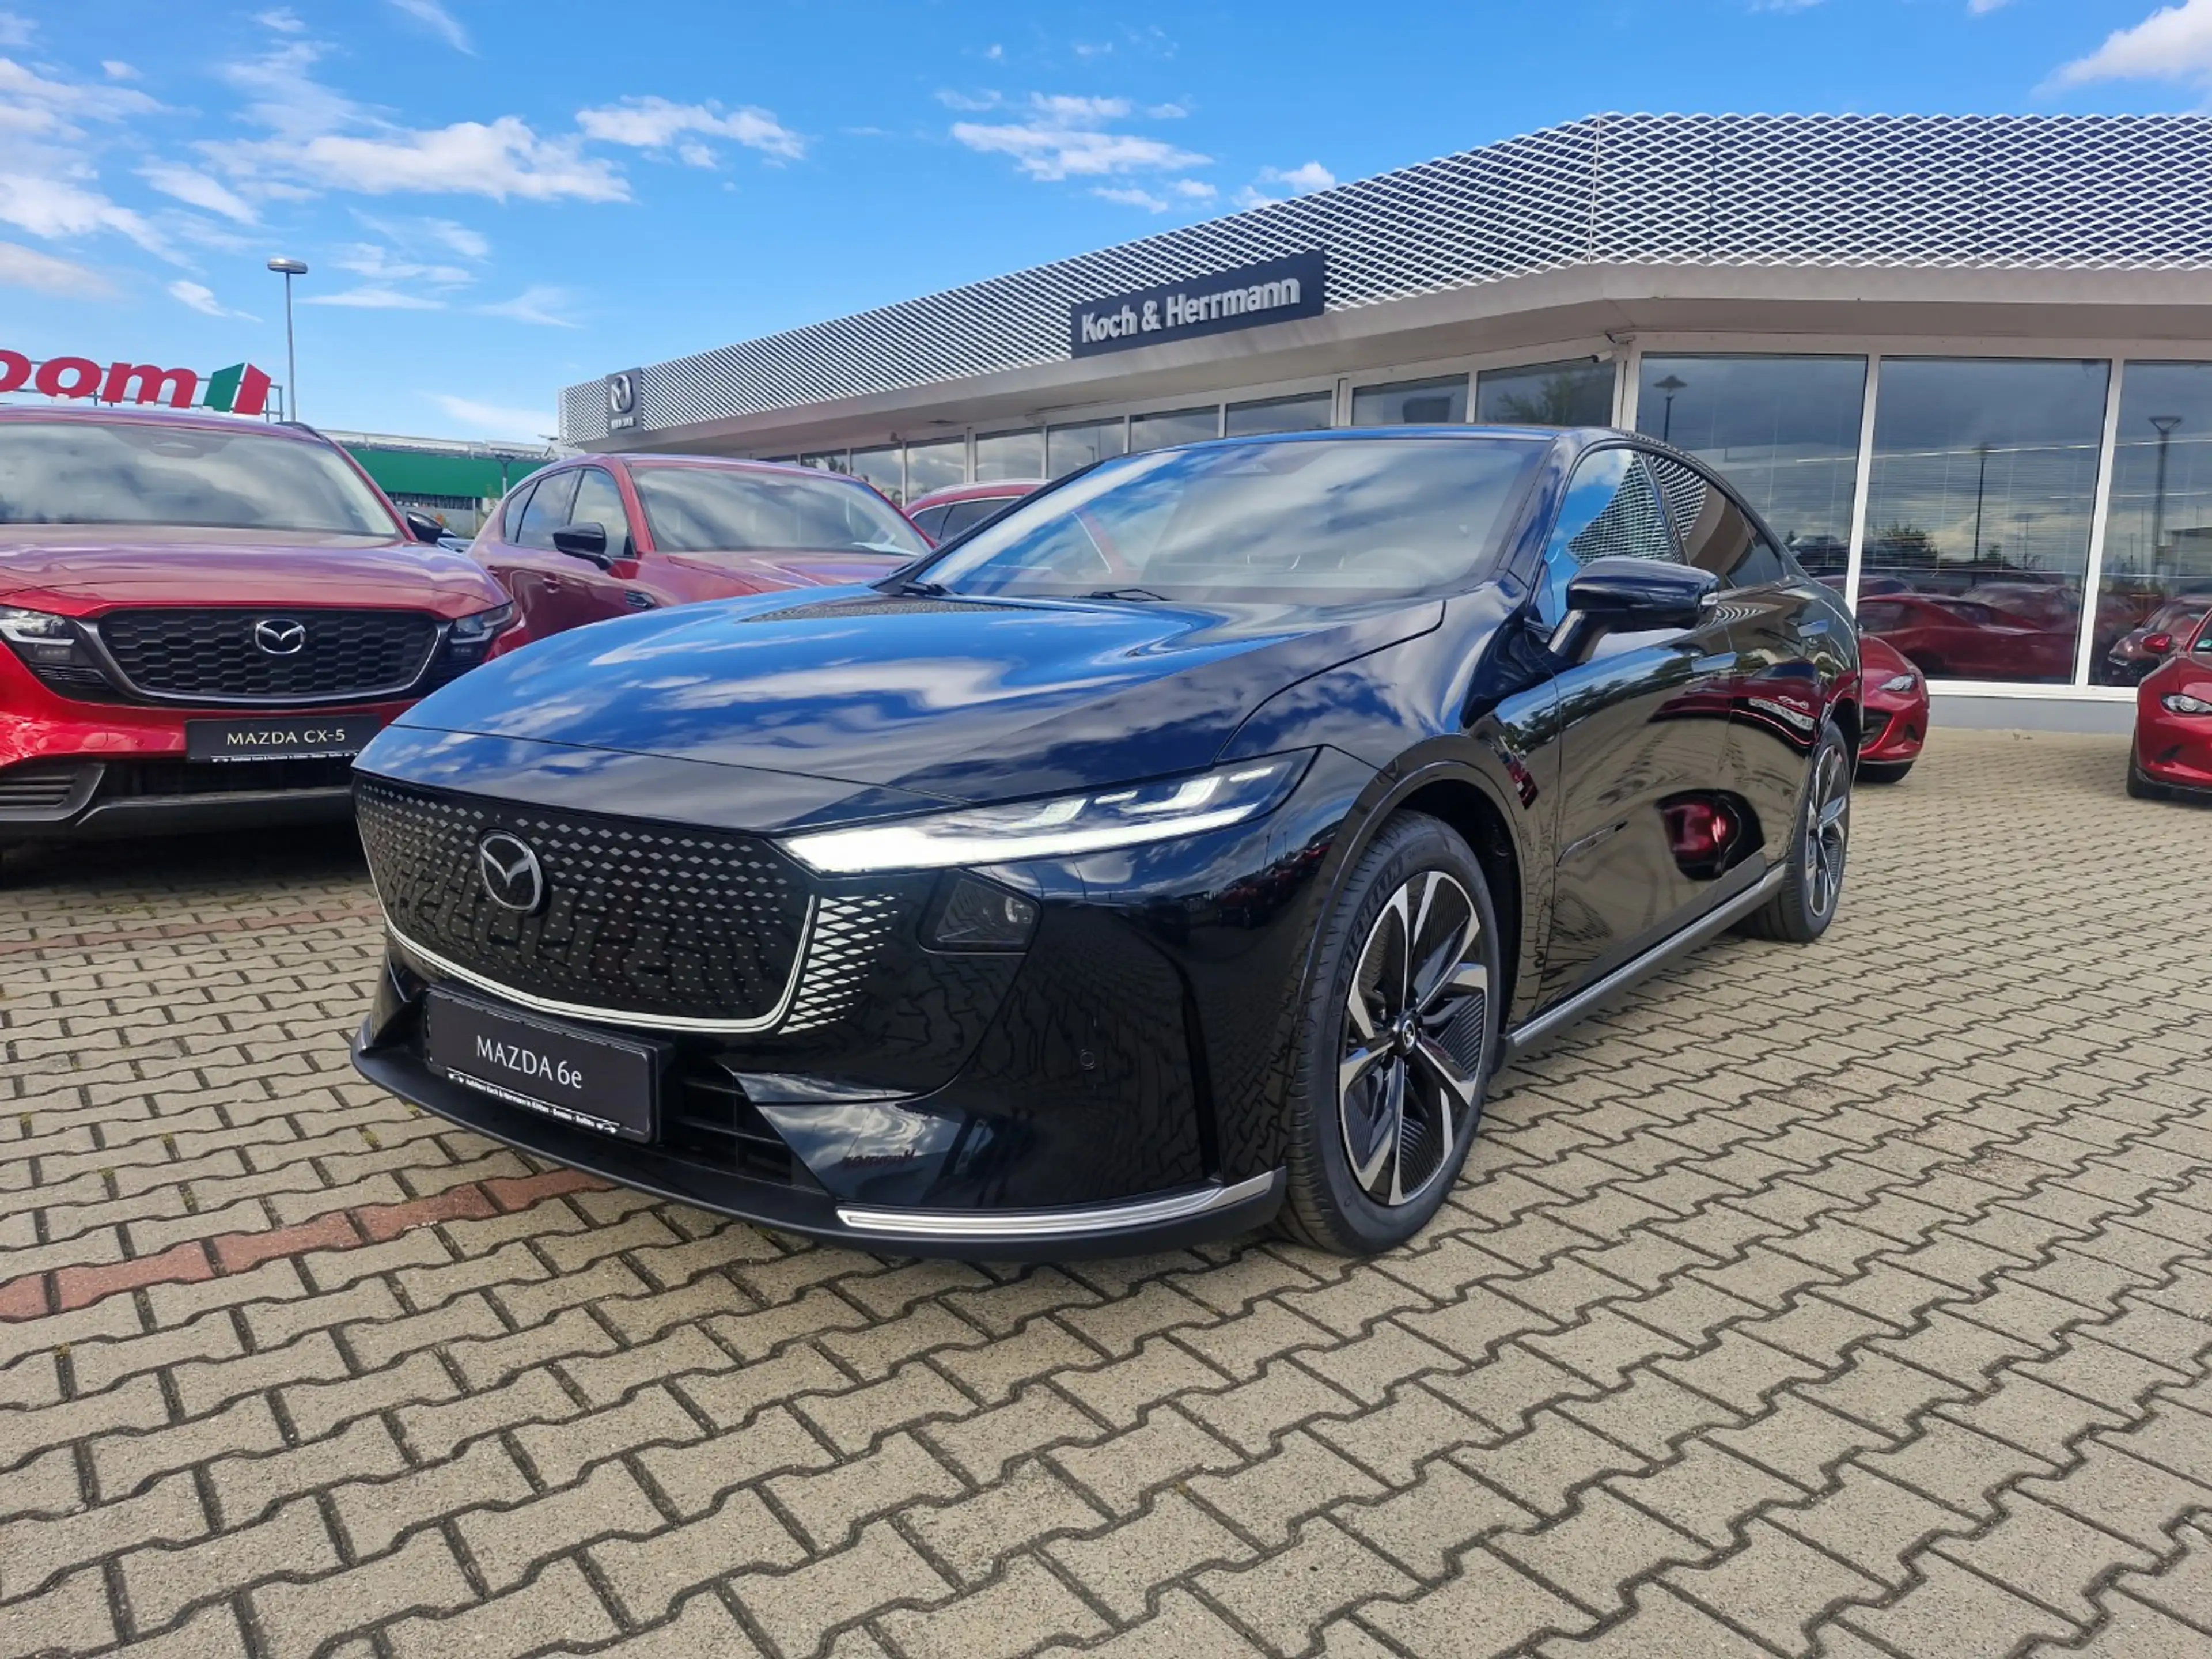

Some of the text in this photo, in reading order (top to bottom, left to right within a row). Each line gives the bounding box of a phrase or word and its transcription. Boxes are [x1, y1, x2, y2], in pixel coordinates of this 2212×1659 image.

[1082, 278, 1301, 343] Koch & Herrmann
[227, 729, 346, 745] MAZDA CX-5
[476, 1035, 582, 1089] MAZDA 6e
